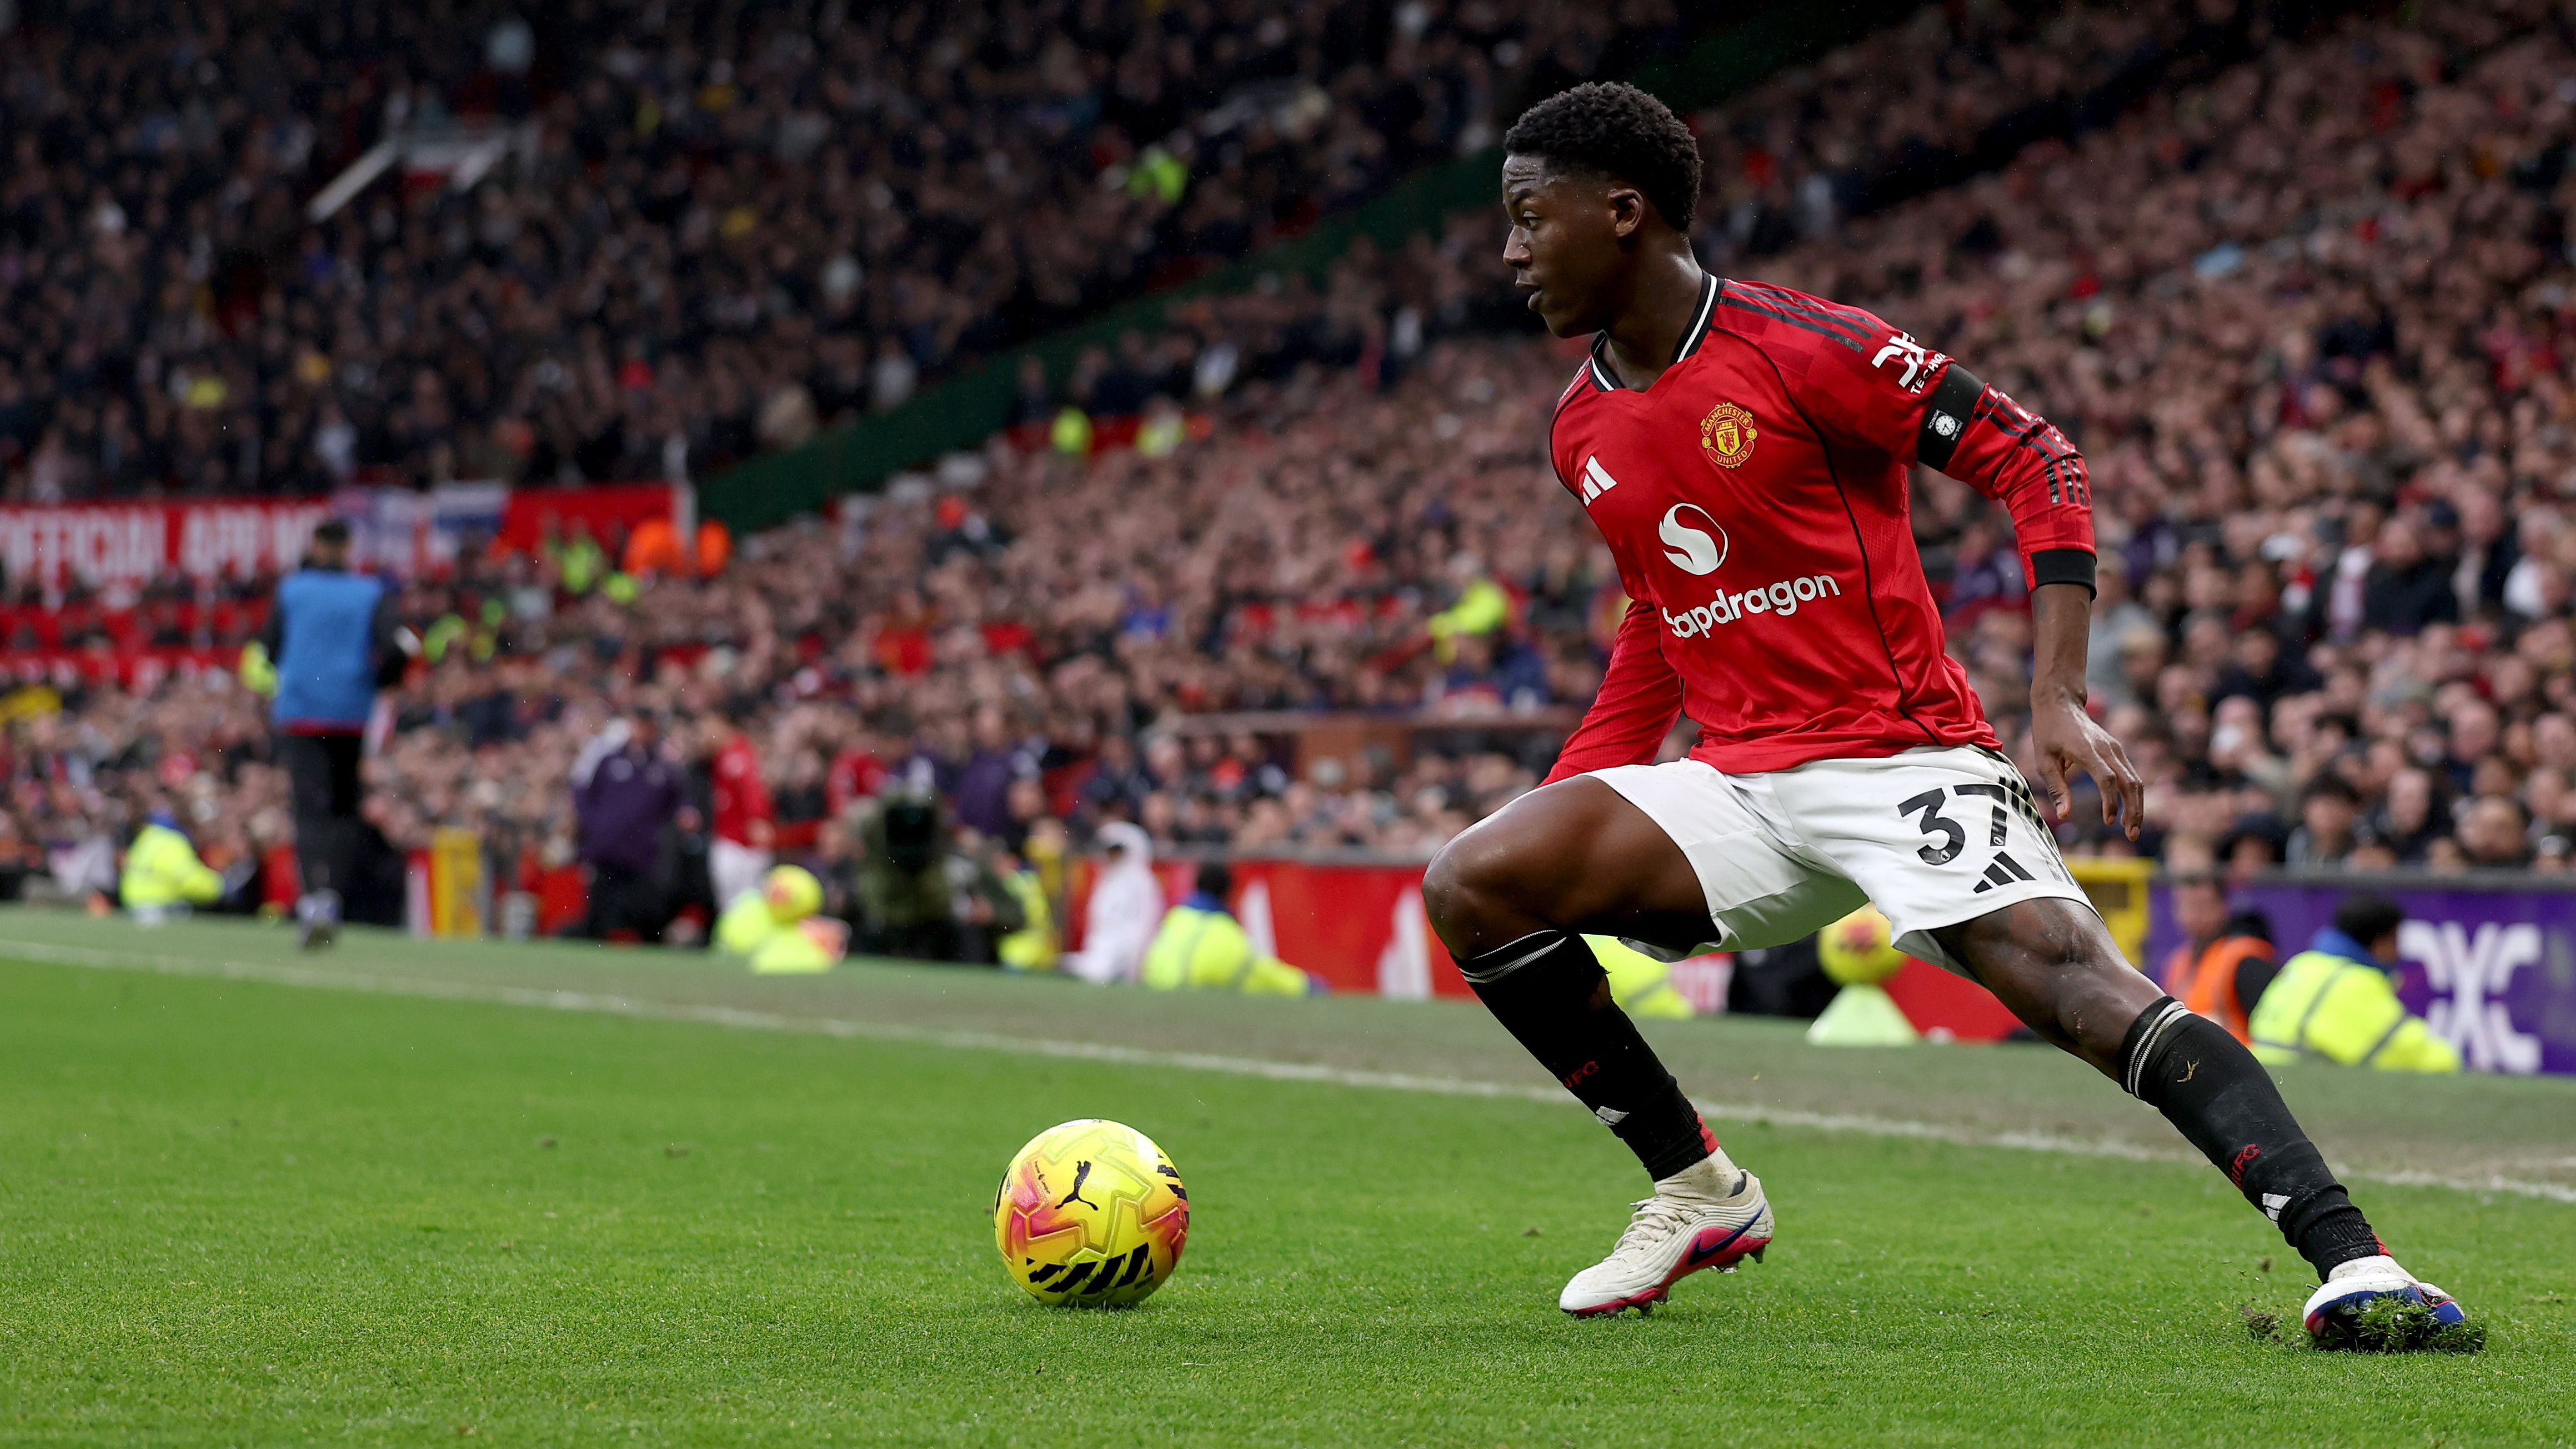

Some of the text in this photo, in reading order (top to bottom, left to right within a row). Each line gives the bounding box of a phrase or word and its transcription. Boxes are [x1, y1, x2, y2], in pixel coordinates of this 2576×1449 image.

[1704, 407, 1749, 432] MANCHESTER
[1717, 450, 1748, 464] UNITED
[1897, 783, 2007, 865] 37
